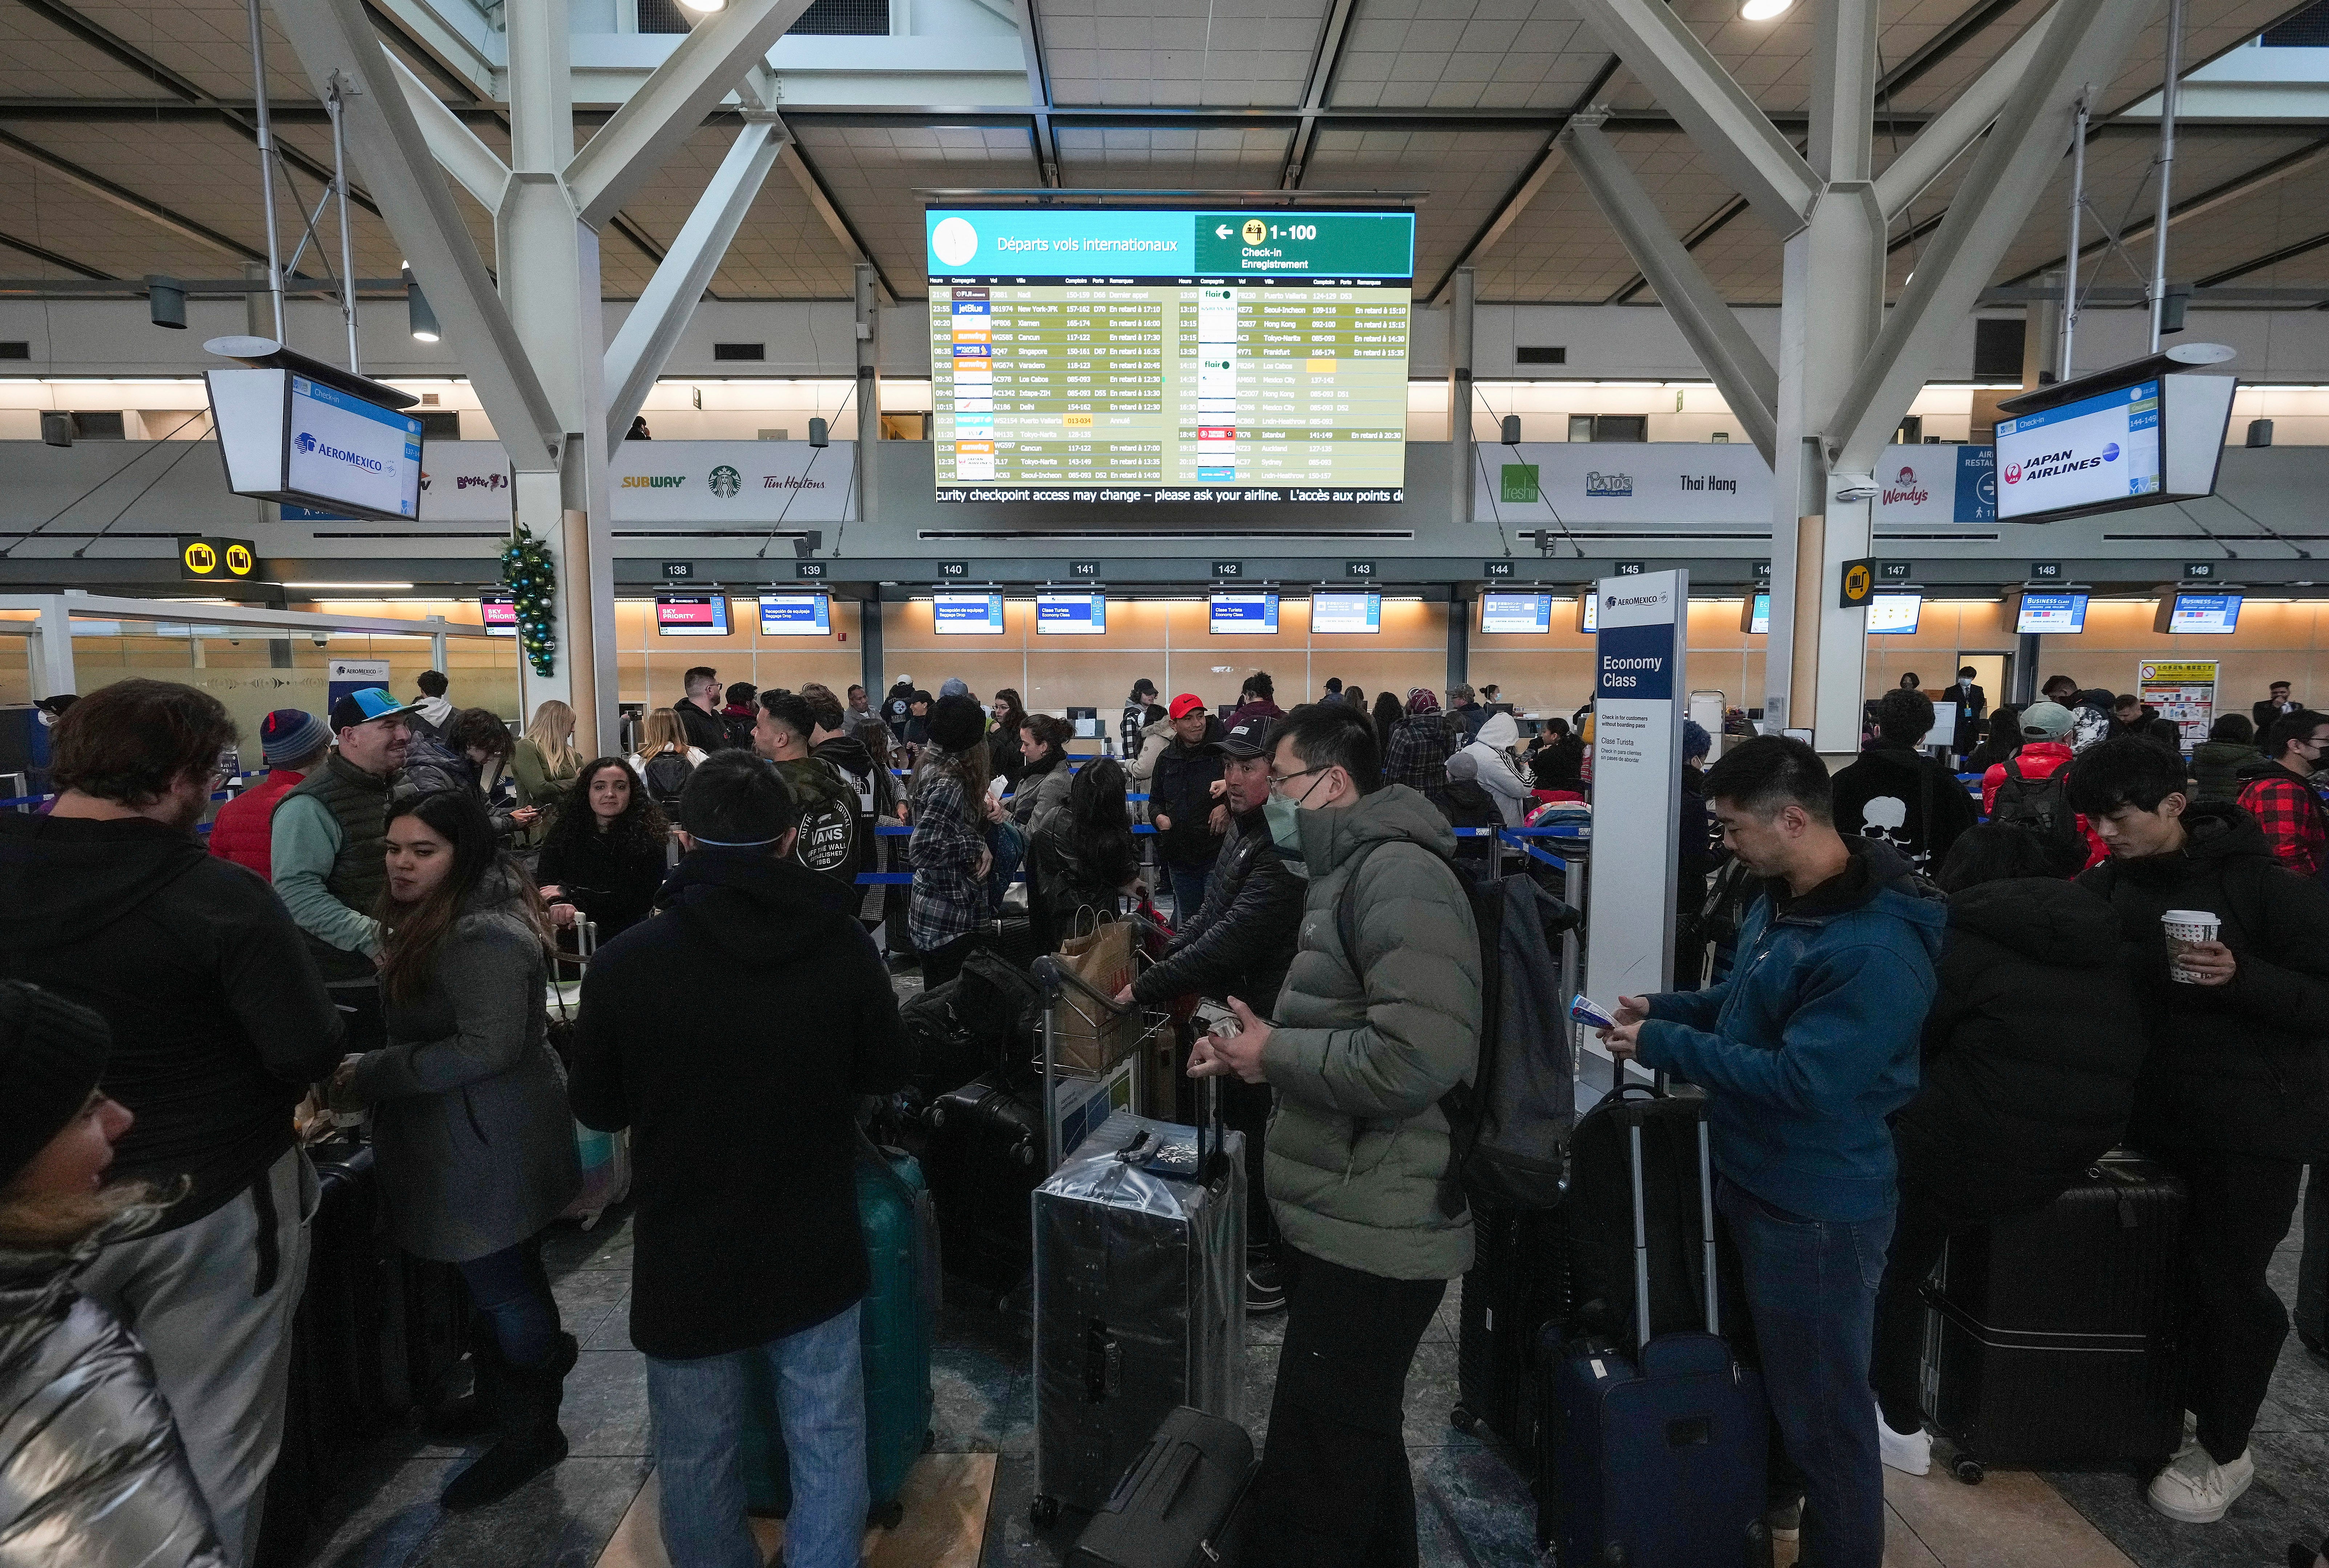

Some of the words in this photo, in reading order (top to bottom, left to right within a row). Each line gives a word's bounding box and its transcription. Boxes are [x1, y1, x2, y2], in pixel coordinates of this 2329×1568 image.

[997, 236, 1048, 253] Départs
[1053, 237, 1079, 251] vols
[1083, 237, 1177, 251] internationaux
[1242, 247, 1281, 257] Check-in
[1242, 259, 1308, 270] Enregistrement
[958, 304, 983, 314] jetBlue
[958, 332, 986, 341] sunwing
[315, 389, 339, 404] Check-in
[2020, 417, 2044, 428] Check-in
[2130, 415, 2156, 427] 144-149
[2023, 450, 2072, 469] JAPAN
[2026, 457, 2101, 481] AIRLINES
[622, 476, 686, 488] SUBWAY
[763, 476, 782, 488] Tim
[785, 476, 825, 489] Hortons
[1681, 475, 1704, 490] Thai
[1708, 476, 1736, 494] Hang
[1504, 476, 1537, 500] freshii
[970, 489, 1030, 503] checkpoint
[1033, 492, 1069, 501] access
[1073, 492, 1097, 503] may
[1100, 489, 1141, 502] change
[1155, 489, 1190, 503] please
[1194, 490, 1212, 501] ask
[1216, 492, 1241, 503] your
[1244, 490, 1281, 501] airline.
[1290, 489, 1329, 501] L'accès
[1333, 492, 1353, 501] aux
[1357, 490, 1390, 503] points
[1883, 486, 1928, 505] Wendy's
[668, 566, 687, 575] 138
[802, 566, 820, 575] 139
[944, 565, 962, 574] 140
[1077, 565, 1094, 574] 141
[1218, 565, 1236, 574] 142
[1352, 565, 1370, 574] 143
[1490, 565, 1508, 574] 144
[1621, 565, 1639, 574] 145
[1759, 566, 1771, 575] 14
[1888, 566, 1905, 575] 147
[2038, 566, 2055, 575] 148
[2190, 566, 2208, 575] 149
[1603, 656, 1662, 671] Economy
[1603, 673, 1636, 687] Class
[834, 803, 850, 828] IGINAL
[801, 816, 814, 839] AUTH
[812, 824, 843, 845] VANS
[808, 849, 816, 857] OFF
[810, 850, 842, 862] ESTABLISHED
